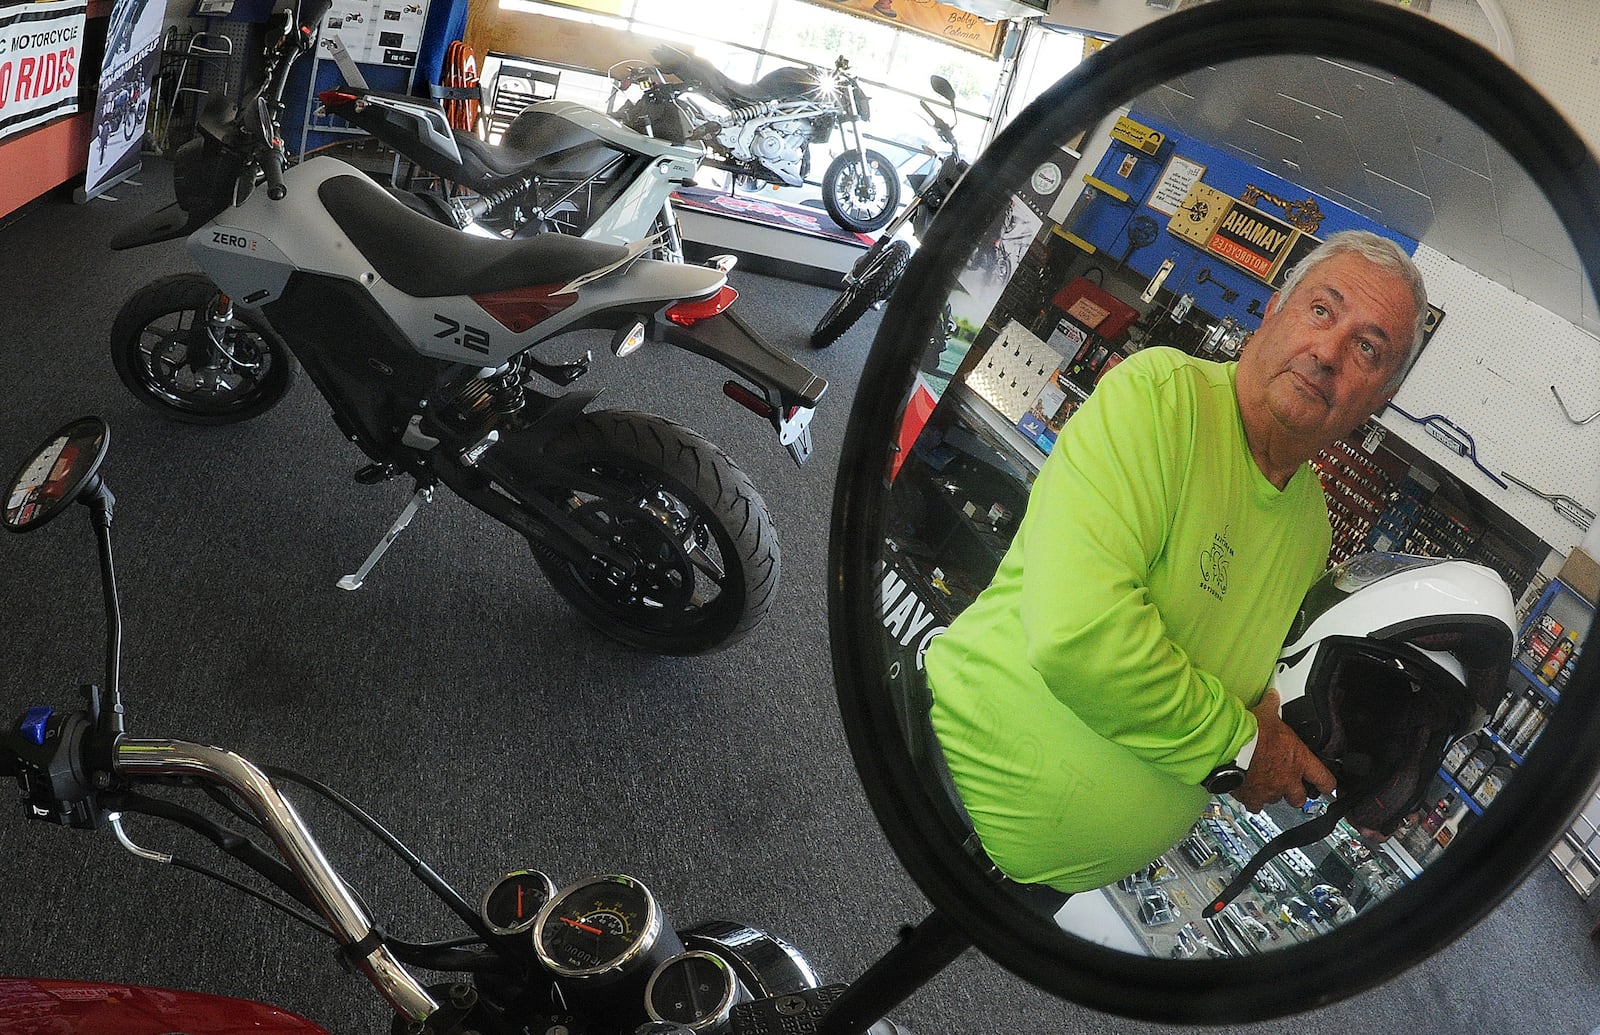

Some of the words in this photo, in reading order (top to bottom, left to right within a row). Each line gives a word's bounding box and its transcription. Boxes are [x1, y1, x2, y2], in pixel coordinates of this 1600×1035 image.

[11, 25, 78, 52] MOTORCYCLE
[14, 46, 75, 102] RIDES
[212, 231, 247, 248] ZERO
[433, 313, 490, 355] 7.2
